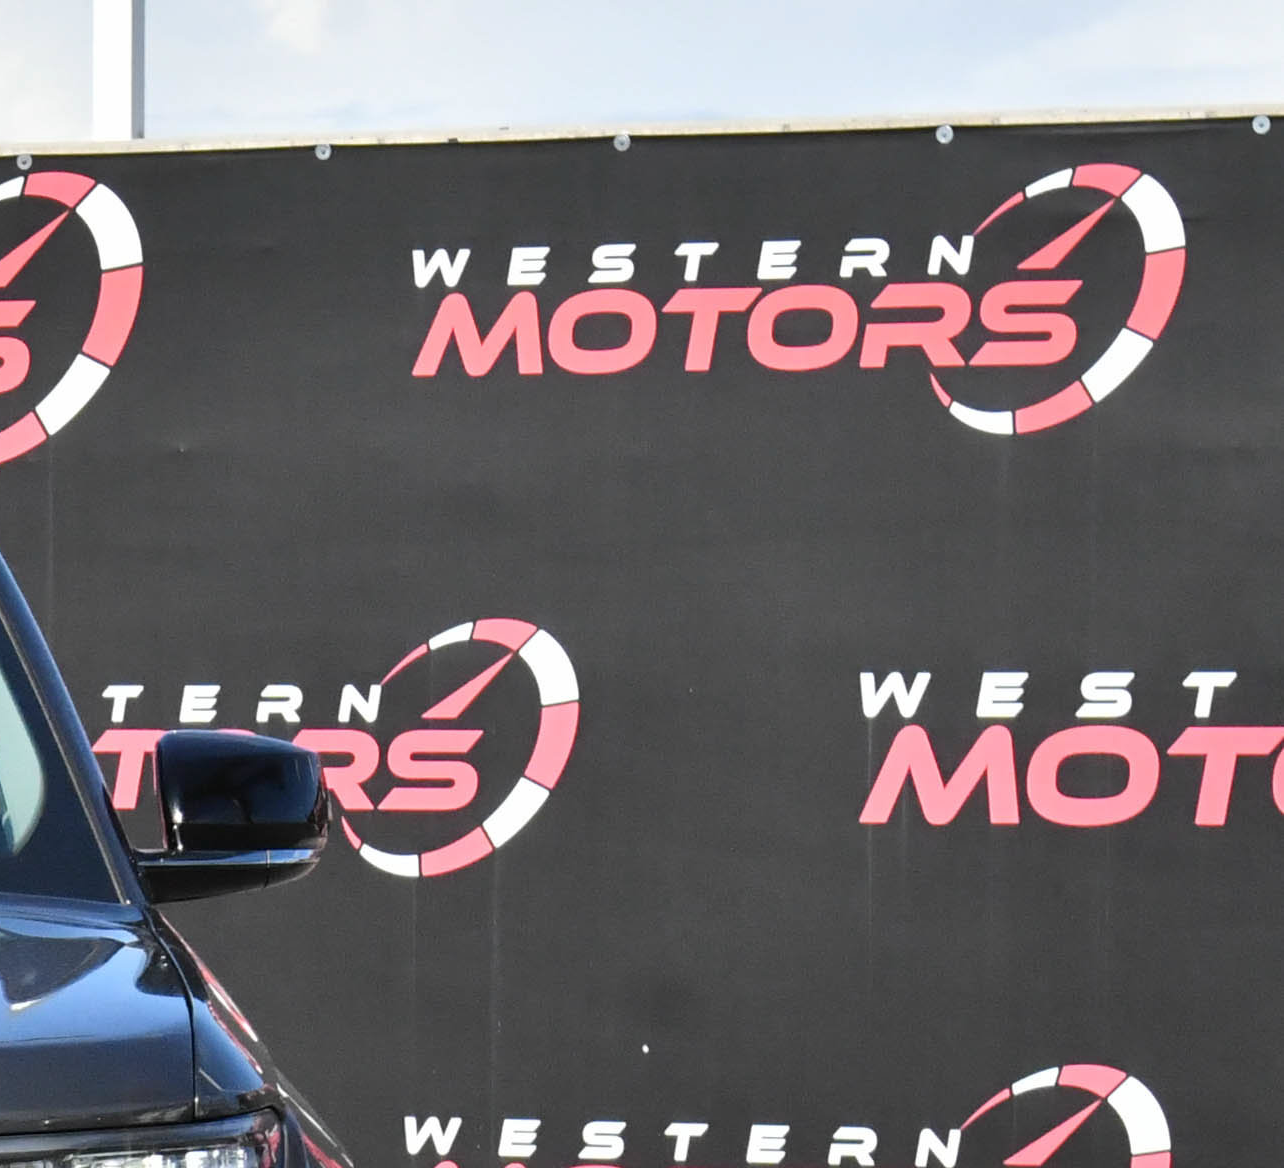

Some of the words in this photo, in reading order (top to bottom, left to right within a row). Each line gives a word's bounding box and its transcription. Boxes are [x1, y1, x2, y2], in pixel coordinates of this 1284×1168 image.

[412, 235, 974, 289] WESTERN
[412, 280, 1082, 377] MOTORS
[92, 729, 483, 811] TRS
[859, 725, 1284, 827] MOT
[404, 1116, 961, 1168] WESTERN
